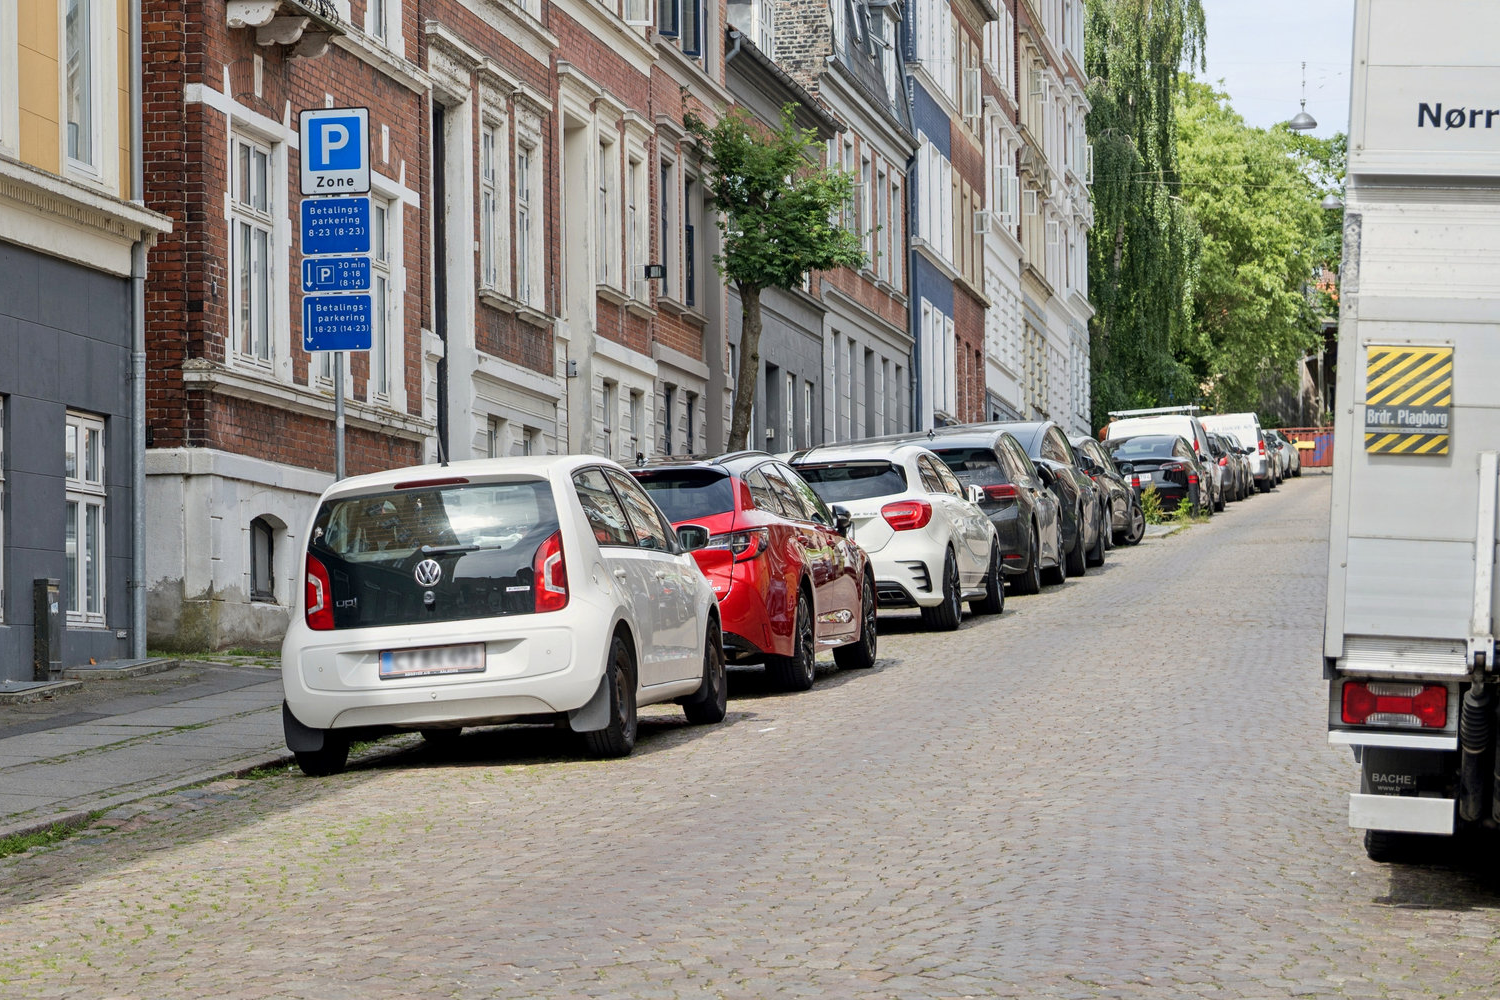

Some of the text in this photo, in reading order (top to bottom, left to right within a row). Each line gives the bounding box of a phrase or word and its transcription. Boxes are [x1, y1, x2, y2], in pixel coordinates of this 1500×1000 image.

[1417, 102, 1500, 130] Nørr
[321, 123, 350, 165] P
[316, 176, 354, 188] Zone
[310, 206, 362, 215] Betalings-
[312, 216, 360, 226] parkering
[308, 227, 365, 237] 8-23 (8-23)
[320, 267, 331, 282] P
[343, 270, 361, 278] 8-18
[316, 304, 367, 312] Betalings-
[318, 314, 365, 323] parkering
[340, 325, 370, 333] (14-23)
[1367, 409, 1448, 428] Brdr. Plagborg
[335, 597, 357, 609] up!
[1372, 773, 1412, 785] BACHE
